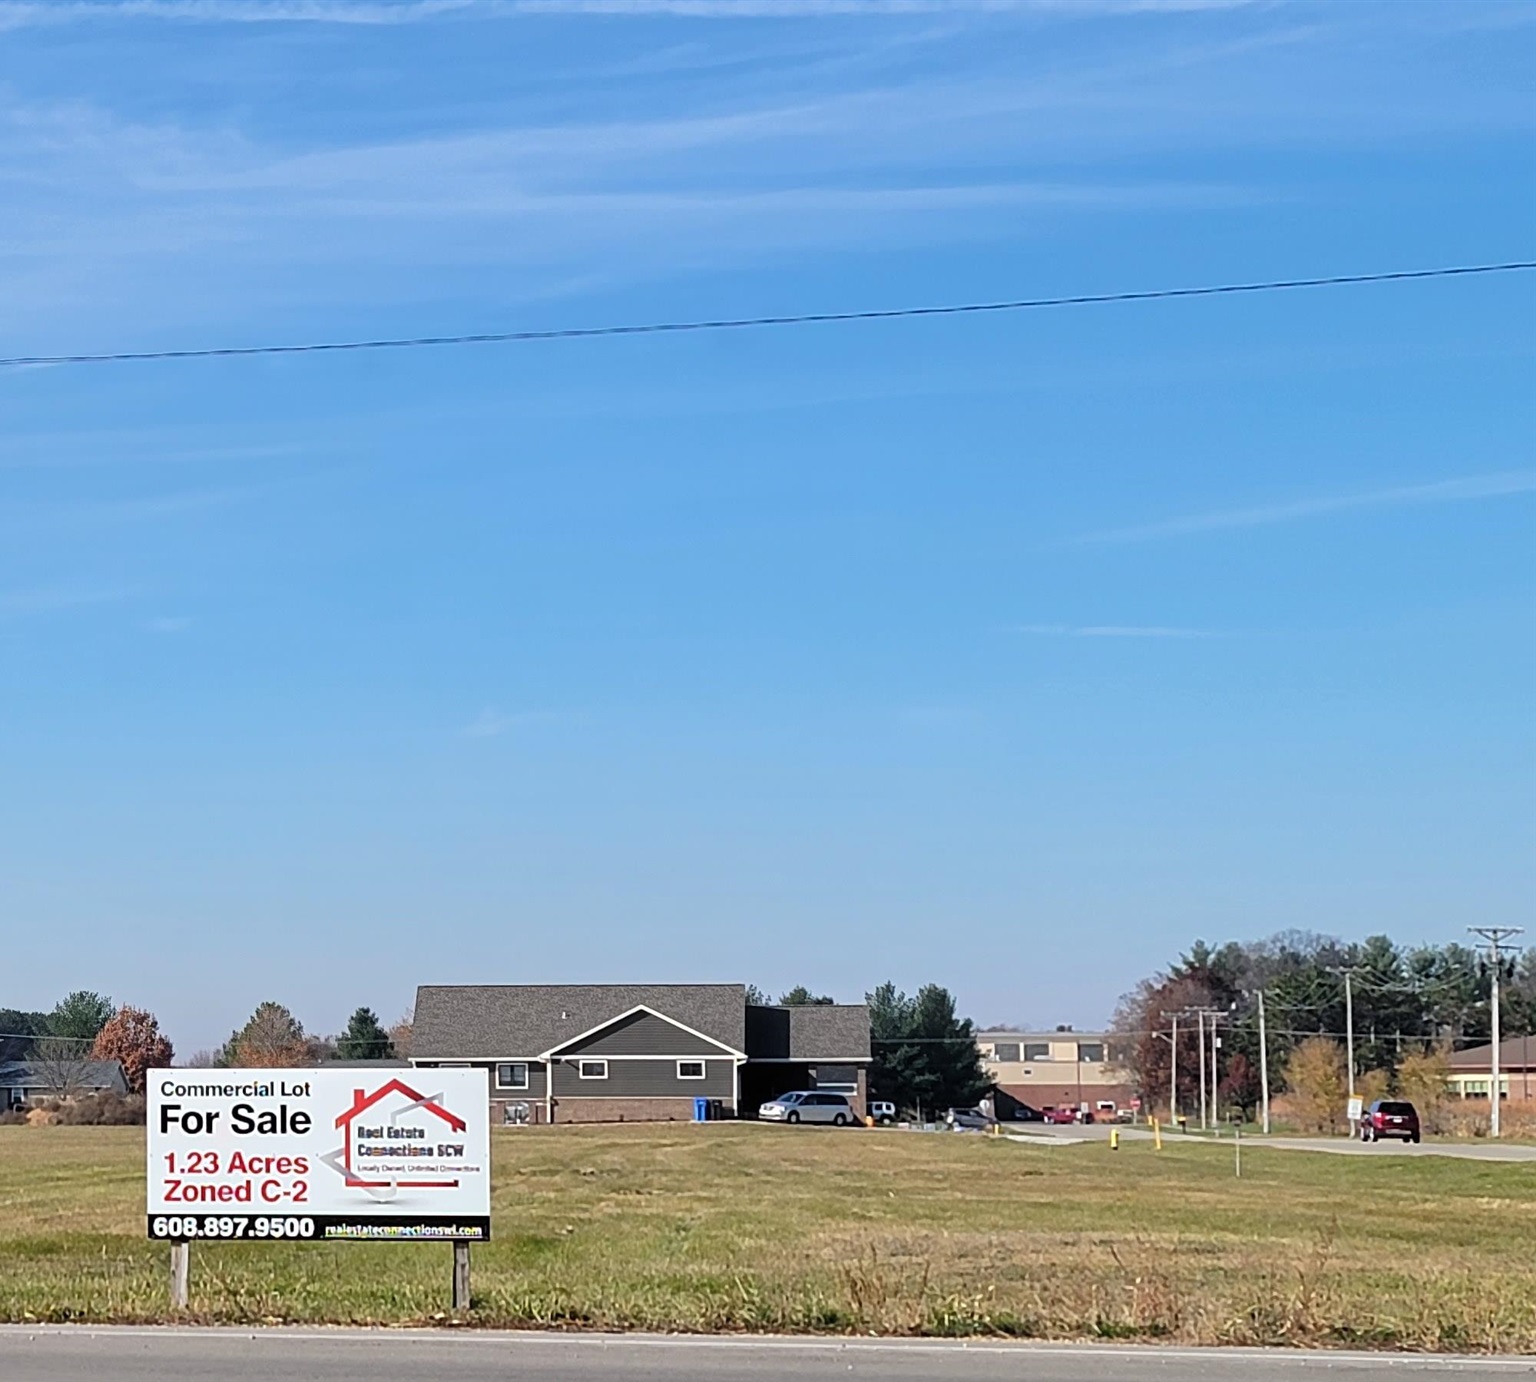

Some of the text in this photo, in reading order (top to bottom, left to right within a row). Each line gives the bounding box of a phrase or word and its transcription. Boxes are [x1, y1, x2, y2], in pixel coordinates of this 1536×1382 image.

[161, 1081, 311, 1097] Commercial Lot
[160, 1103, 312, 1134] For Sale
[357, 1125, 425, 1139] Real Estate
[357, 1143, 464, 1157] Connections SCW
[164, 1151, 309, 1174] 1.23 Acres
[164, 1179, 308, 1202] Zoned C-2
[152, 1216, 315, 1238] 608.897.9500
